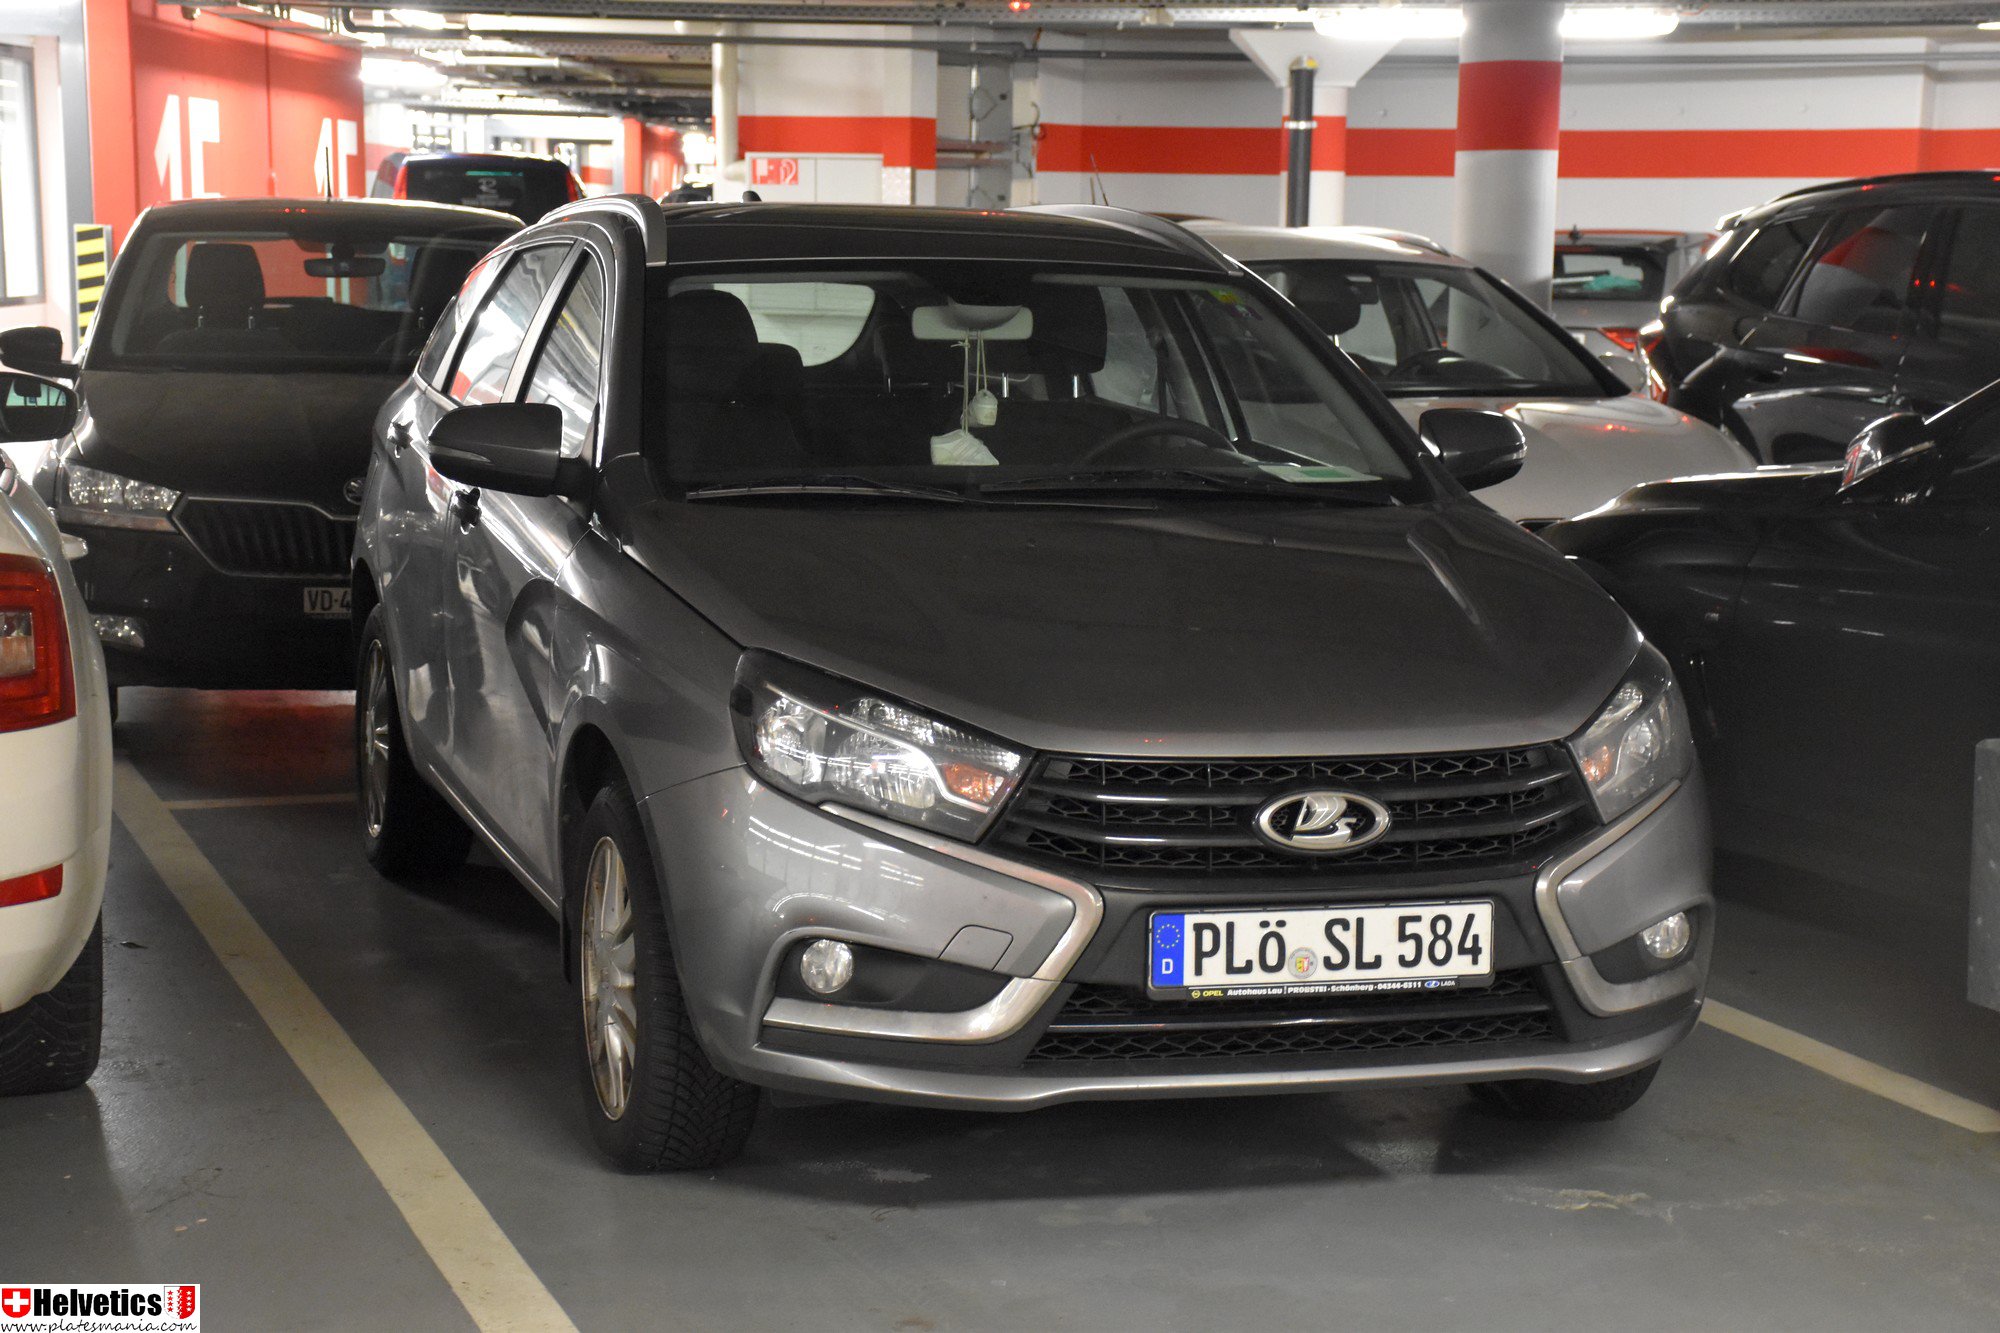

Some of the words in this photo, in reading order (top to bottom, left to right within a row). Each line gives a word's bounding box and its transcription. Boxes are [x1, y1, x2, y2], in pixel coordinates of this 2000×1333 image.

[1193, 919, 1286, 976] PLÖ
[1323, 917, 1382, 971] SL
[1398, 913, 1483, 968] 584
[1161, 958, 1174, 975] D
[1227, 988, 1267, 997] Autohaus
[1268, 987, 1283, 995] Lau
[1330, 983, 1374, 993] Schönberg
